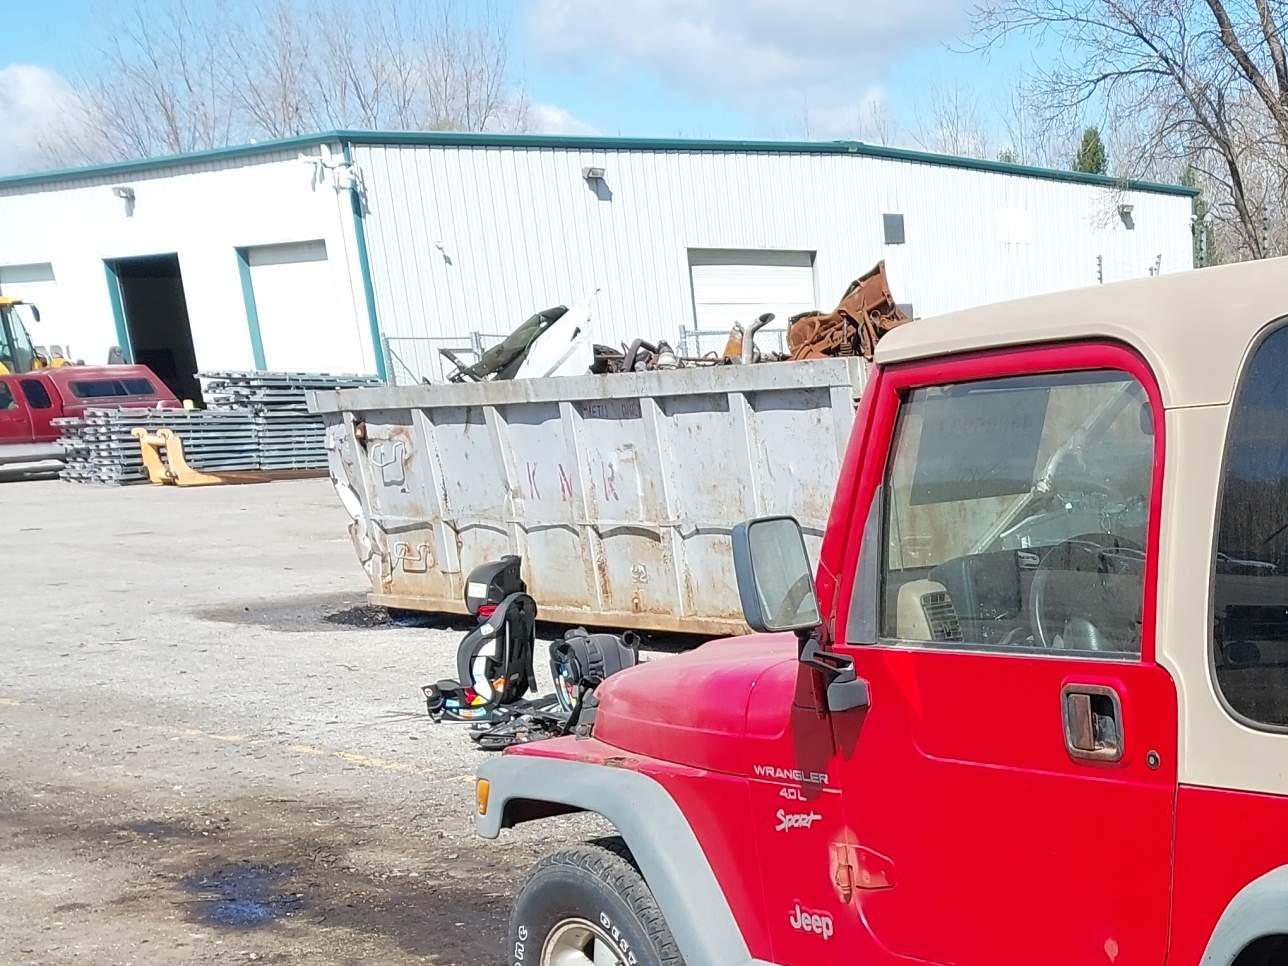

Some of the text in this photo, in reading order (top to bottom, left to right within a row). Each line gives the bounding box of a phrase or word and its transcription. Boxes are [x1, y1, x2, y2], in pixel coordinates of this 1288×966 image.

[753, 764, 829, 785] WRANGLER
[775, 808, 823, 833] Sport
[790, 903, 834, 940] Jeep
